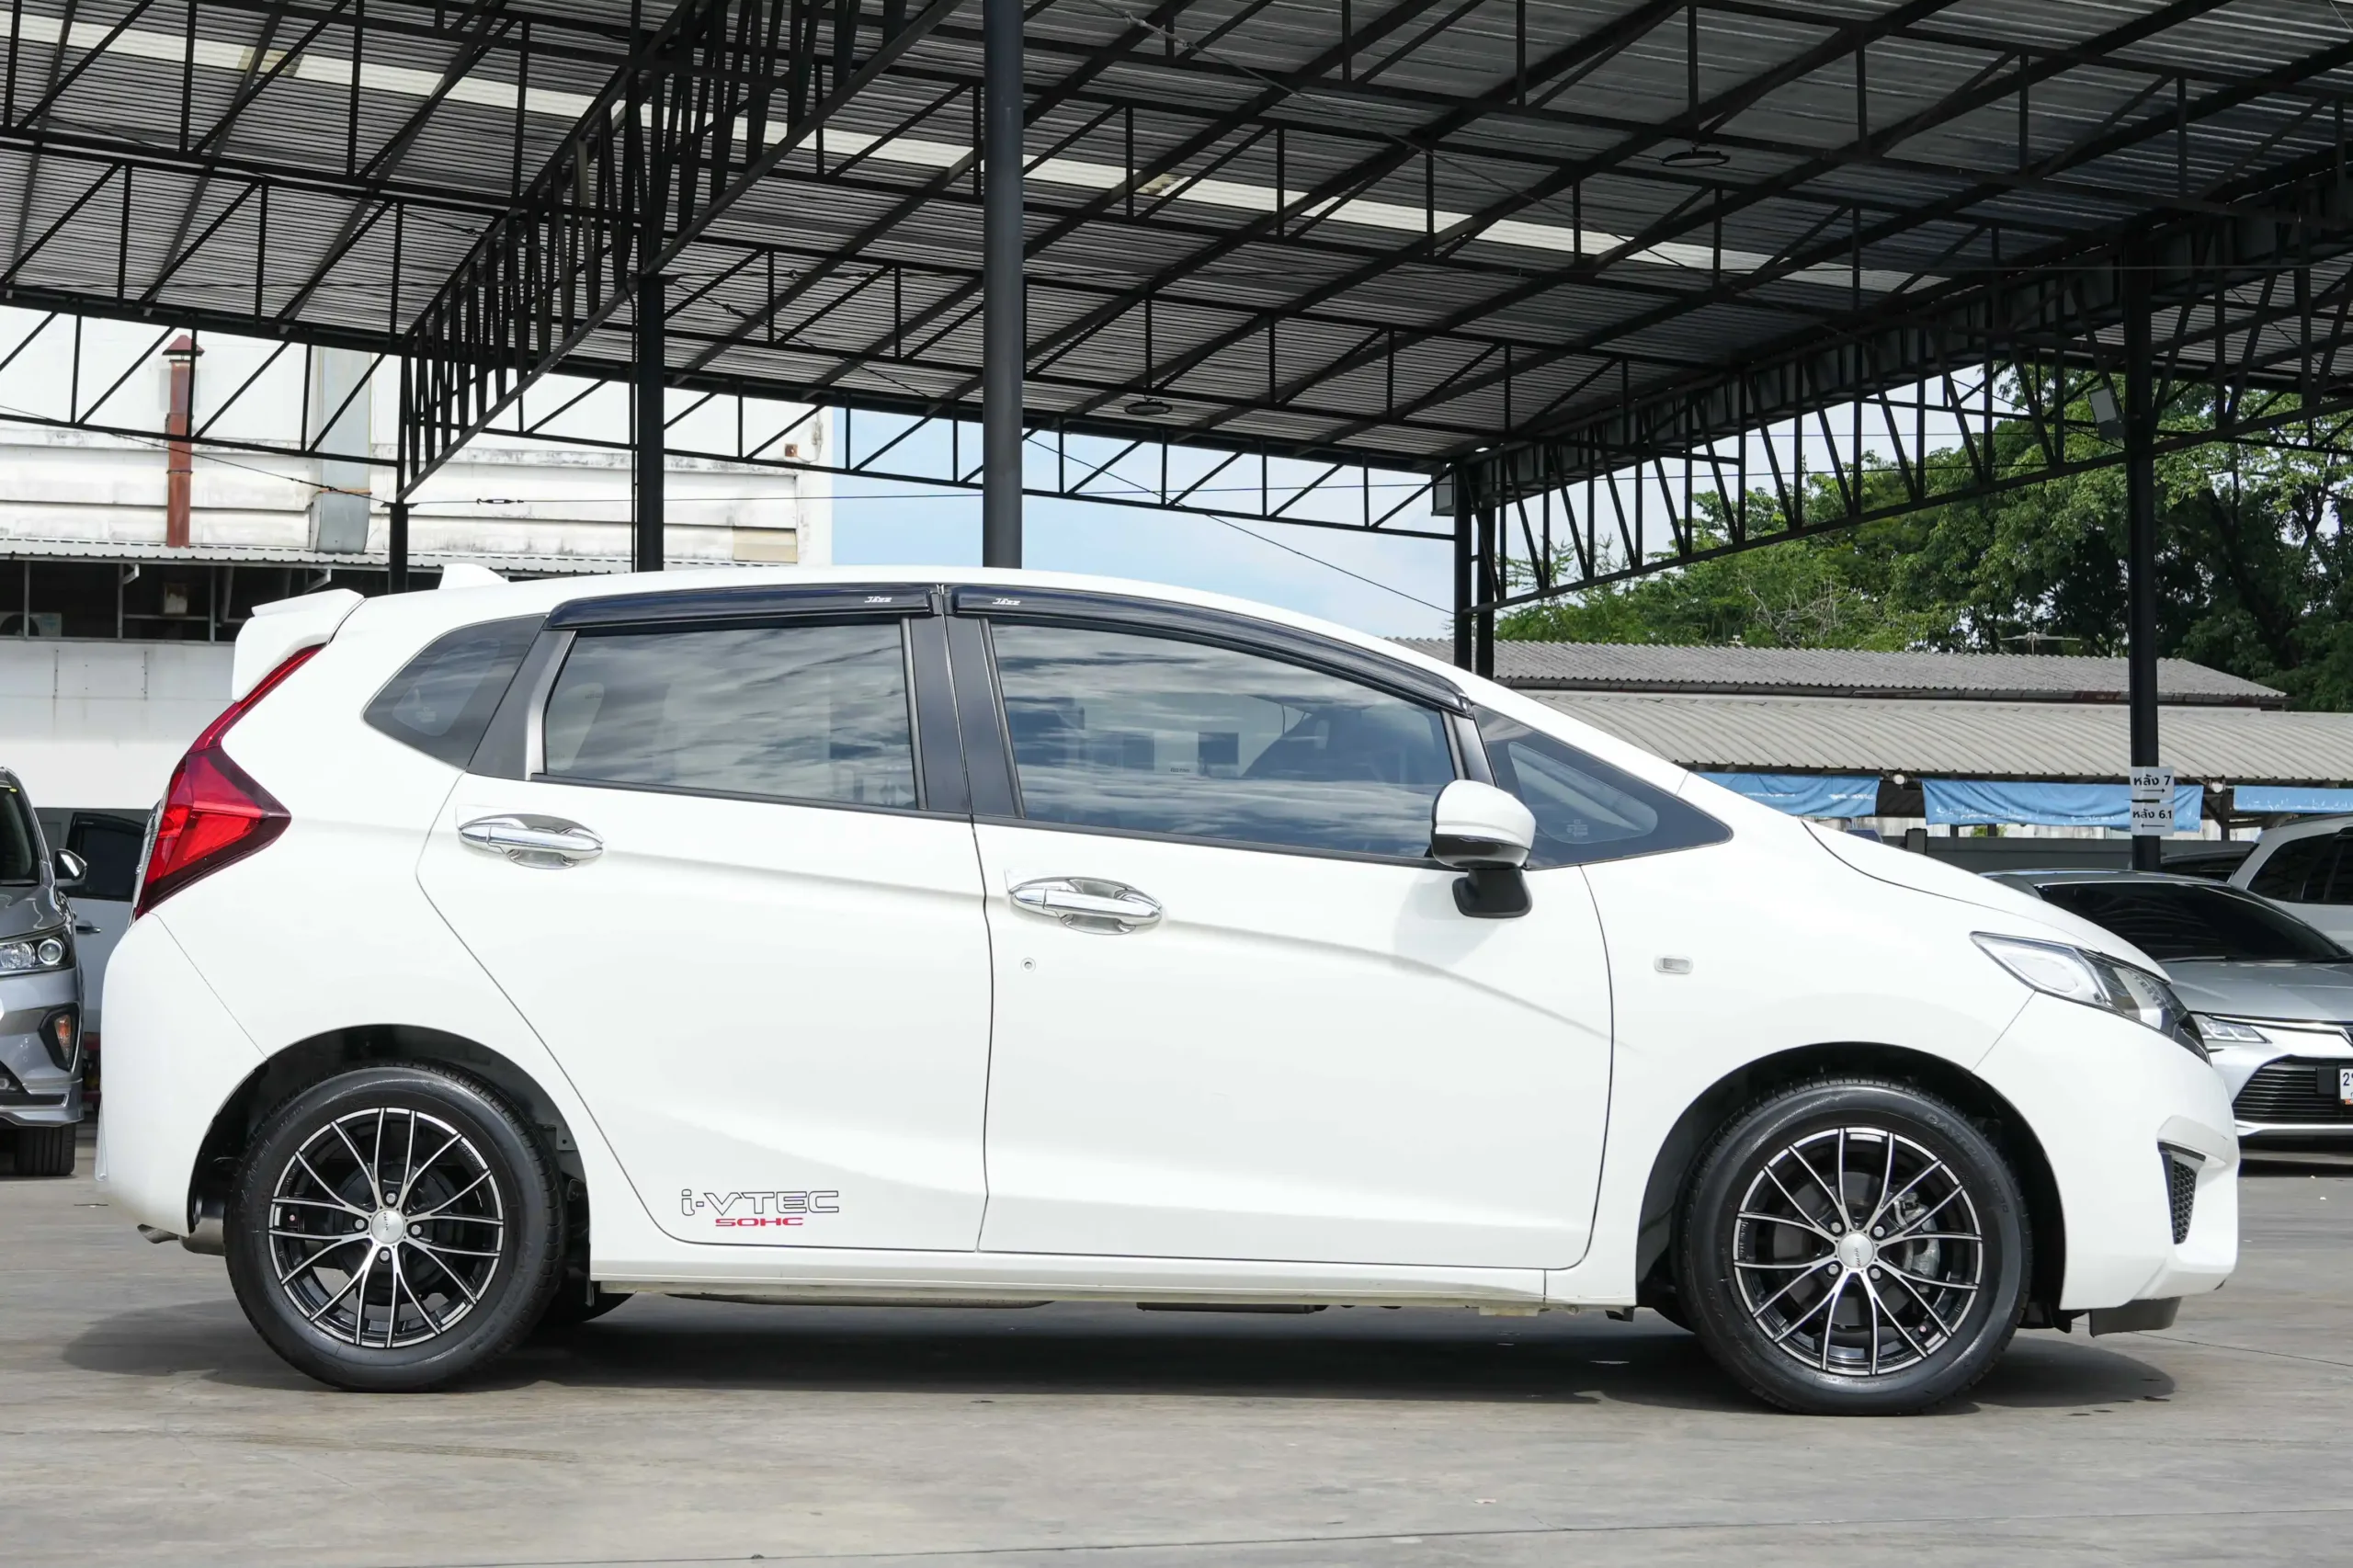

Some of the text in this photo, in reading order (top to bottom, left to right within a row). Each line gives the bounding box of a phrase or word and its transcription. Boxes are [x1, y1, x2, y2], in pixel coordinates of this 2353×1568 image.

[2133, 774, 2171, 786] หลัง 7
[2132, 808, 2172, 819] หลัง 6.1
[681, 1188, 840, 1216] i-VTEC
[715, 1217, 804, 1227] SOHC
